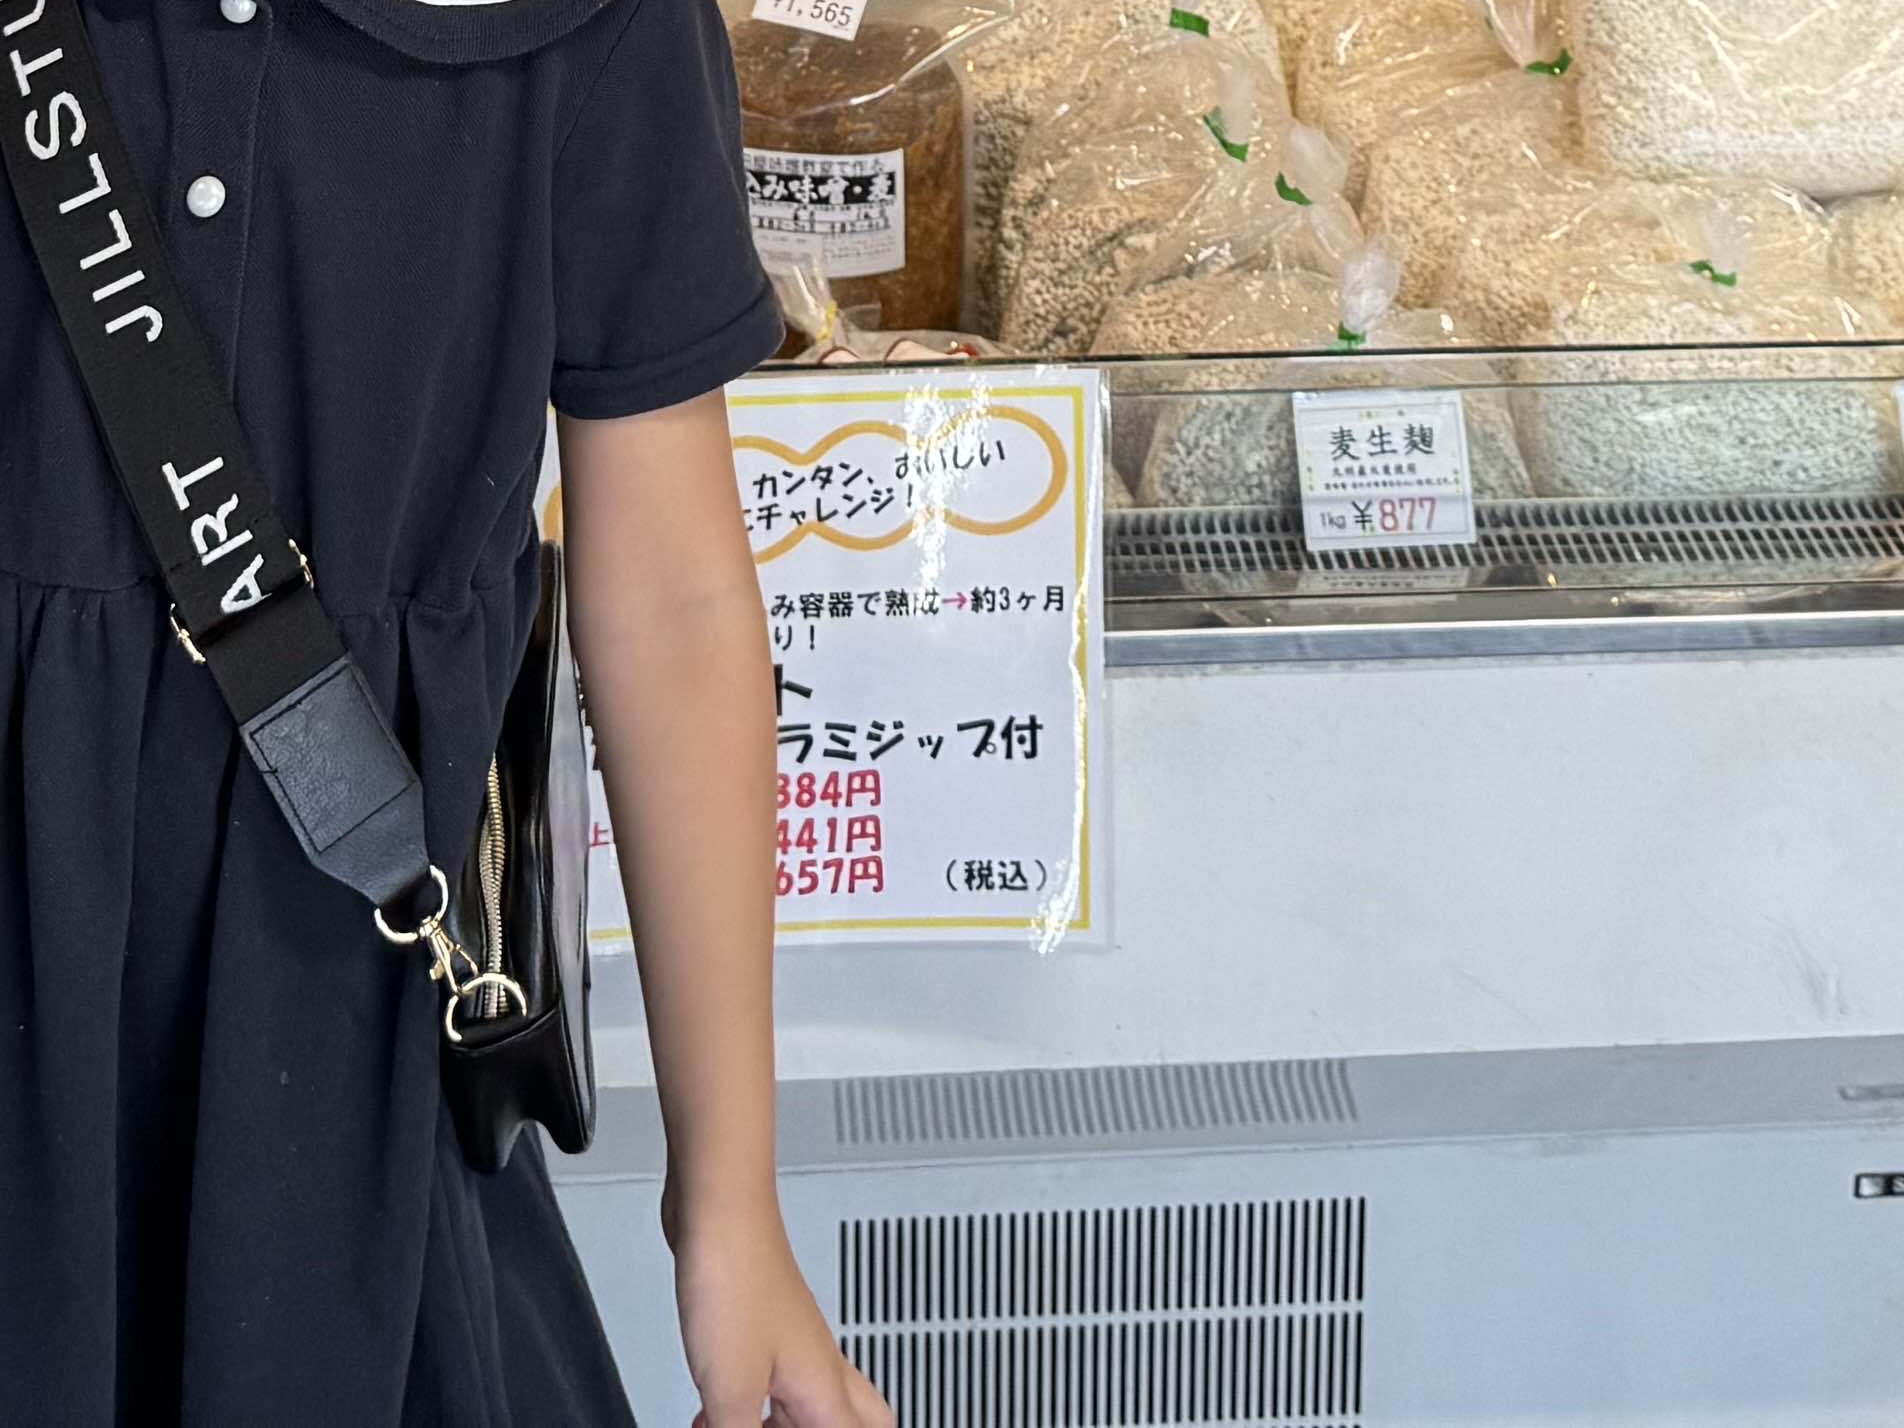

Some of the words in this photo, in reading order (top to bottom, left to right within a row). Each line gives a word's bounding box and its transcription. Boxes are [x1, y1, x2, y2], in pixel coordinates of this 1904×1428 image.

[1329, 424, 1435, 461] 麦生麹
[1320, 512, 1347, 530] 1kg
[1351, 496, 1437, 532] ¥877
[162, 457, 267, 615] ART
[777, 715, 1043, 764] ラミジップ付
[775, 855, 884, 896] 657円
